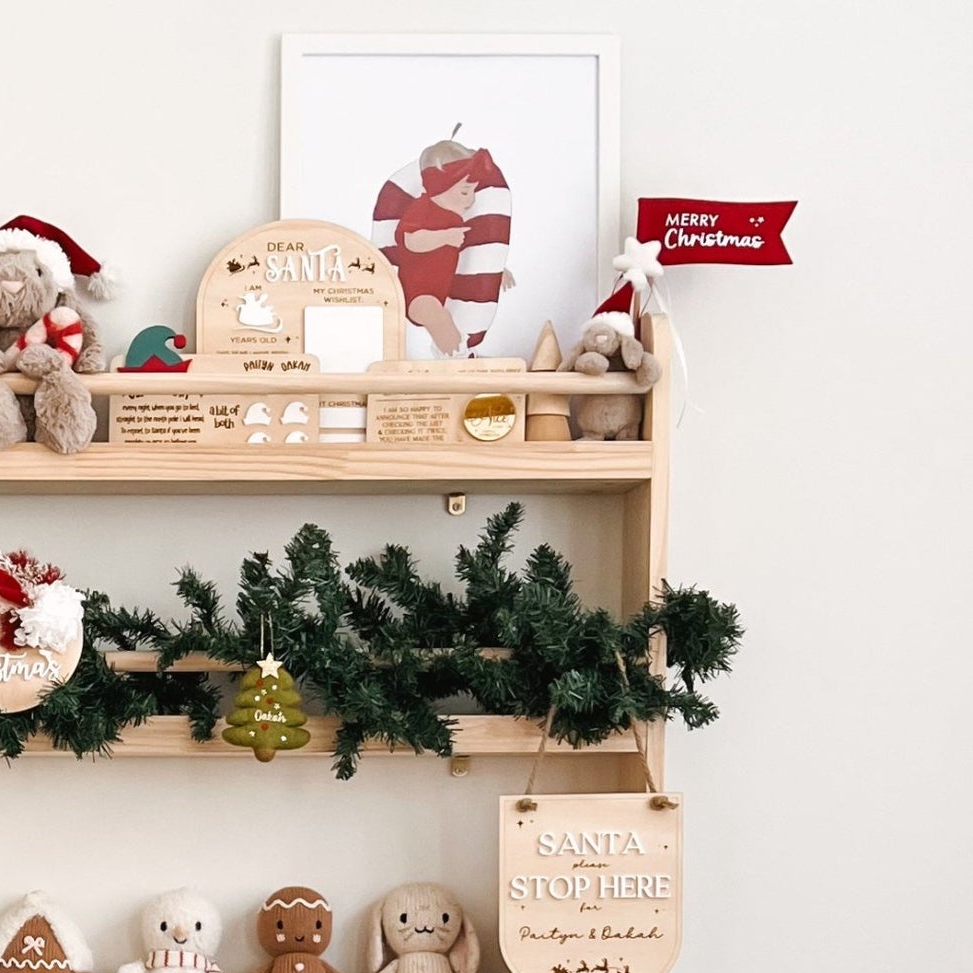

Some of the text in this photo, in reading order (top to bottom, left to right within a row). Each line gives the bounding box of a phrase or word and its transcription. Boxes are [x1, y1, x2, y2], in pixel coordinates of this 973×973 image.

[665, 213, 719, 227] MERRY
[664, 227, 765, 249] Christmas
[267, 242, 305, 252] DEAR
[265, 244, 346, 283] SANTA
[230, 336, 277, 344] YEARS OLD
[230, 404, 240, 415] of
[214, 418, 235, 429] both
[538, 831, 646, 856] SANTA
[572, 859, 611, 870] please
[510, 874, 673, 900] STOP HERE
[579, 902, 603, 914] for
[518, 926, 585, 945] Paityn
[588, 928, 597, 940] &
